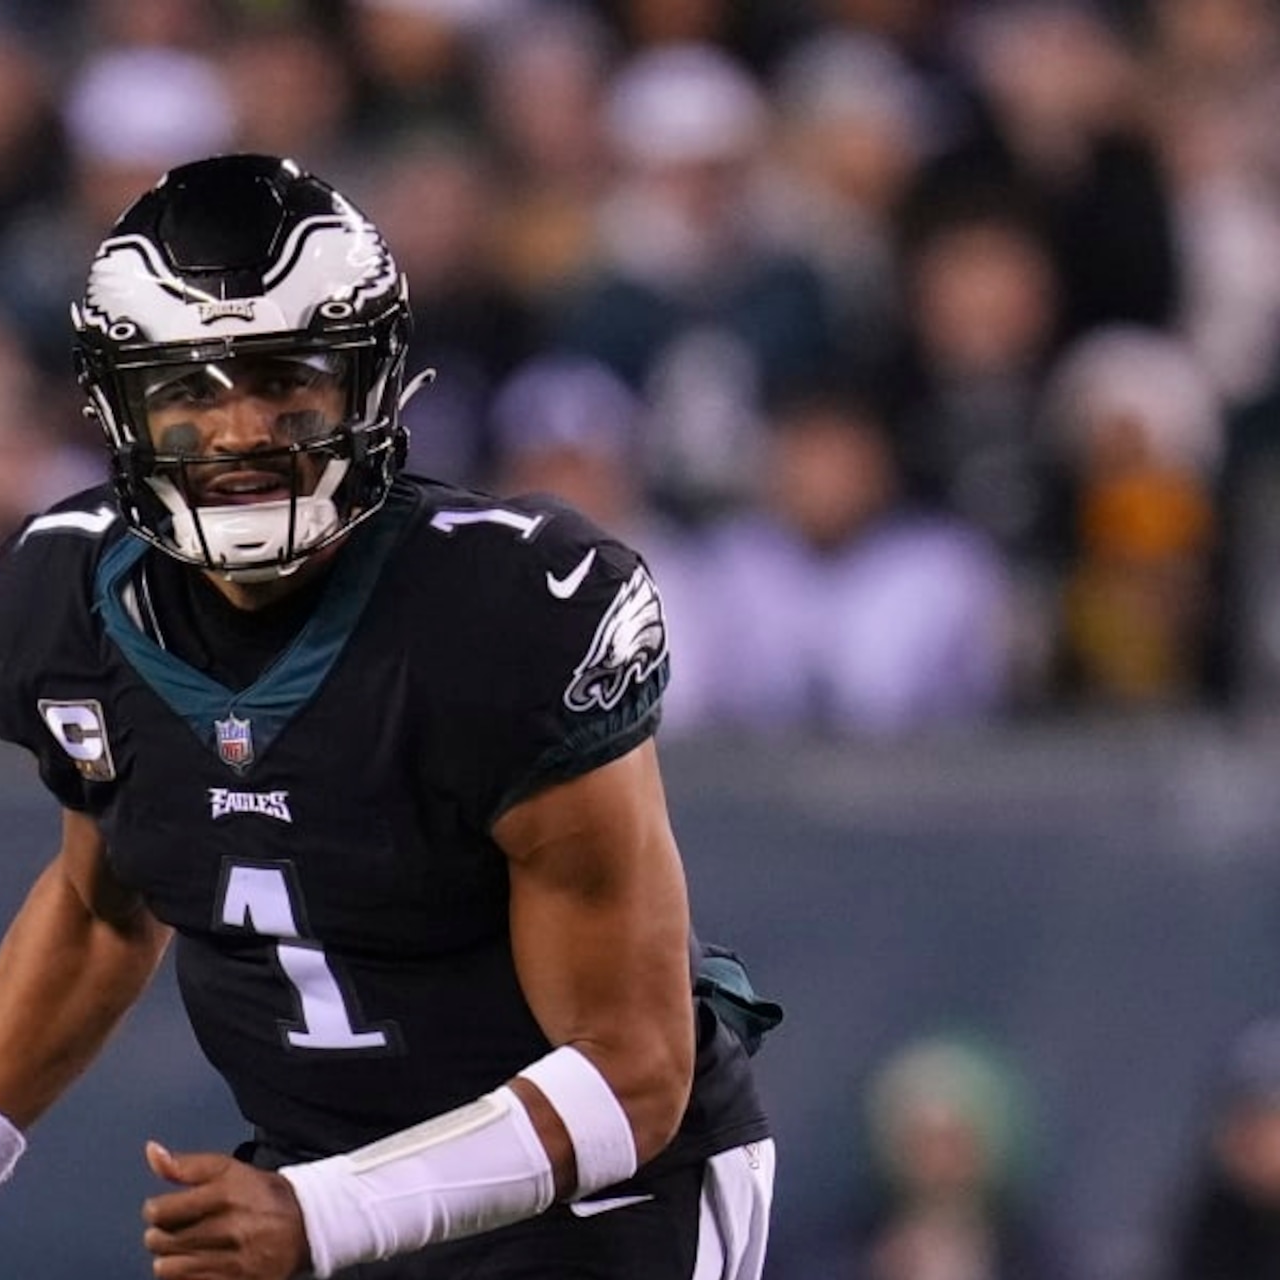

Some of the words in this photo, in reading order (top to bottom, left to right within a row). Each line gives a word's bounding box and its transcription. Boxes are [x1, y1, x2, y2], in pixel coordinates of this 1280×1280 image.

[430, 508, 544, 540] 1
[46, 706, 103, 761] C
[208, 788, 293, 824] EAGLES
[223, 866, 387, 1049] 1
